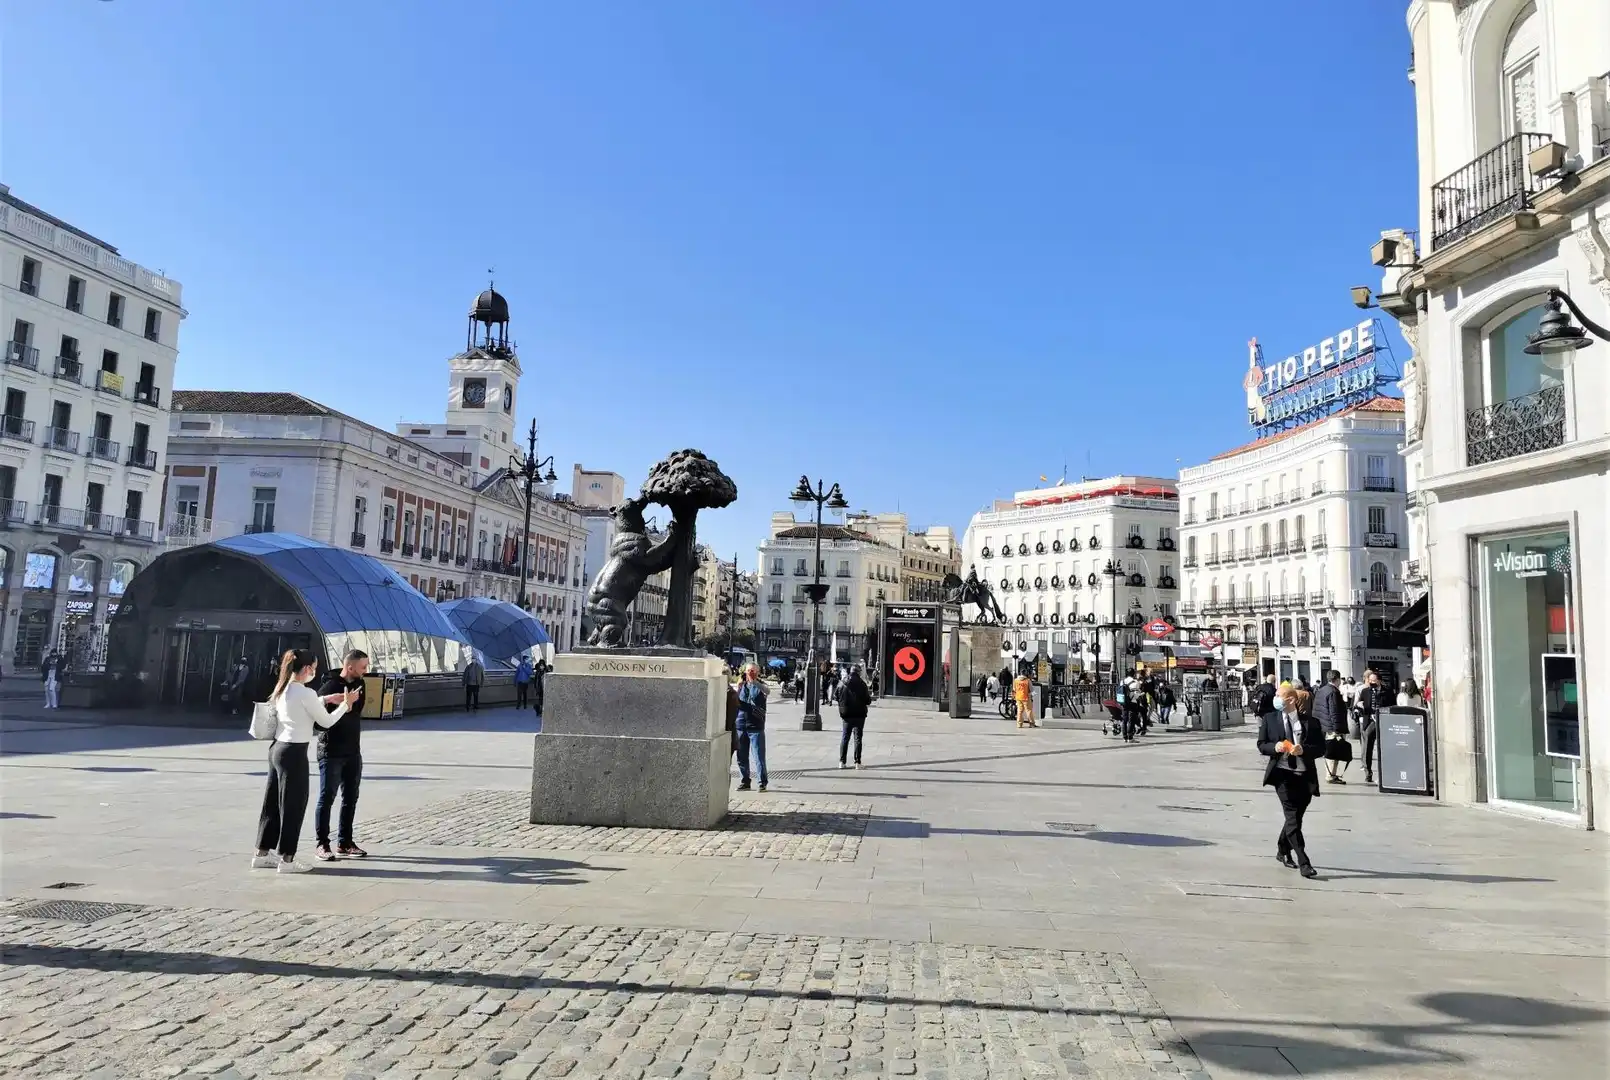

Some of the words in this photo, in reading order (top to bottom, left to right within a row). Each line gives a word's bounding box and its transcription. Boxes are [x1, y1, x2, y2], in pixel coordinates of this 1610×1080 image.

[1265, 356, 1296, 390] TIO
[1304, 318, 1374, 376] PEPE
[67, 601, 94, 609] ZAPSHOP
[588, 662, 600, 671] 50
[601, 660, 630, 672] AÑOS
[632, 663, 646, 672] EN
[648, 664, 667, 673] SOL
